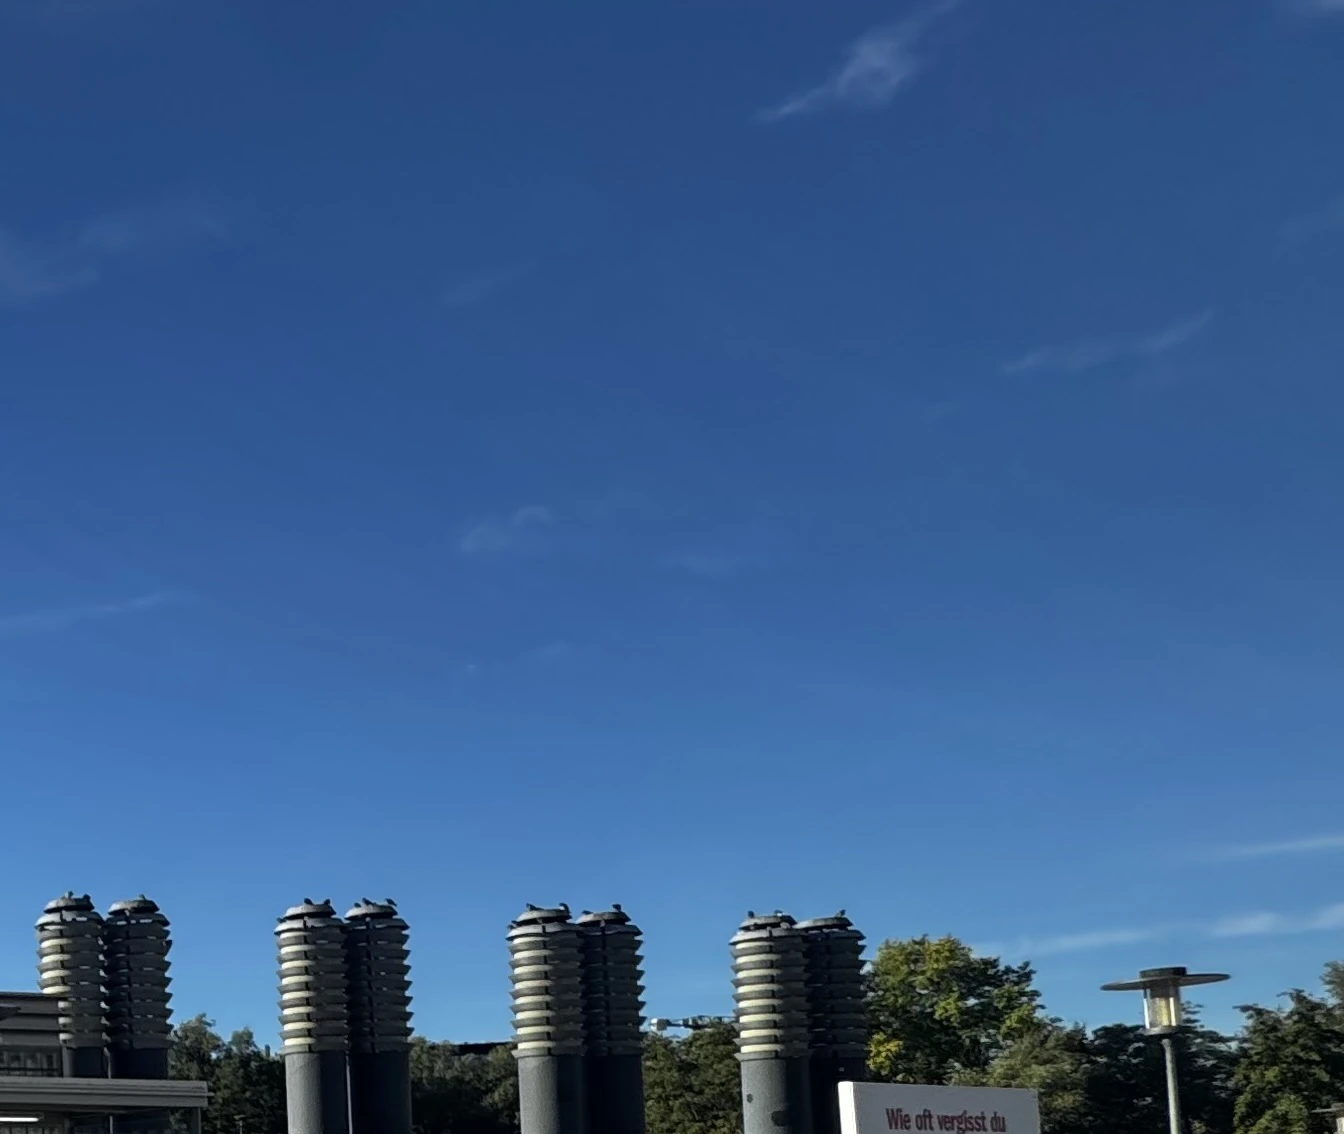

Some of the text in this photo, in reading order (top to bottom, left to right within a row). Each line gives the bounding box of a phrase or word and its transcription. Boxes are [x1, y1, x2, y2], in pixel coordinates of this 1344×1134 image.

[885, 1107, 912, 1131] Wie
[915, 1108, 934, 1131] oft
[990, 1111, 1006, 1132] du
